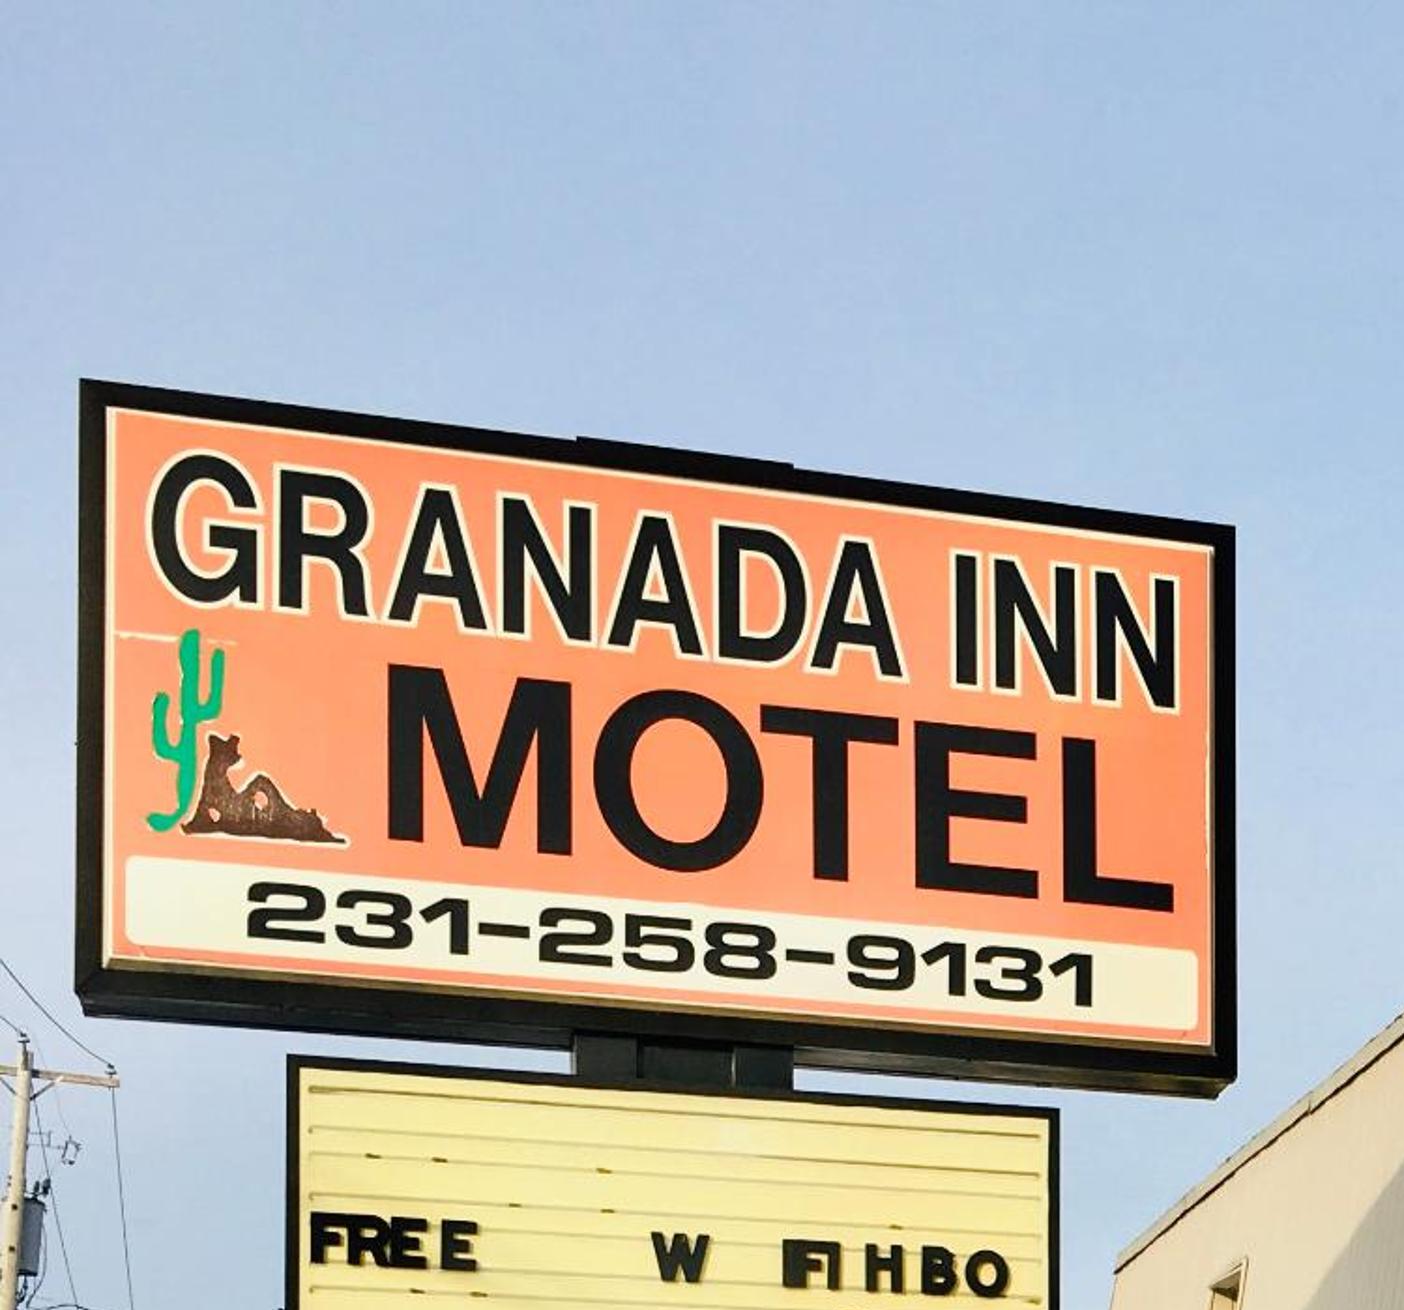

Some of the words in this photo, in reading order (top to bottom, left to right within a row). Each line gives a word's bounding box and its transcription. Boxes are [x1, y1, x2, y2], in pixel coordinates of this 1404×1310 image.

[149, 451, 905, 680] GRANADA
[953, 552, 1178, 711] INN
[387, 663, 1175, 914] MOTEL
[247, 882, 1093, 1007] 231-258-9131
[310, 1211, 478, 1272] FREE
[651, 1232, 710, 1283] W
